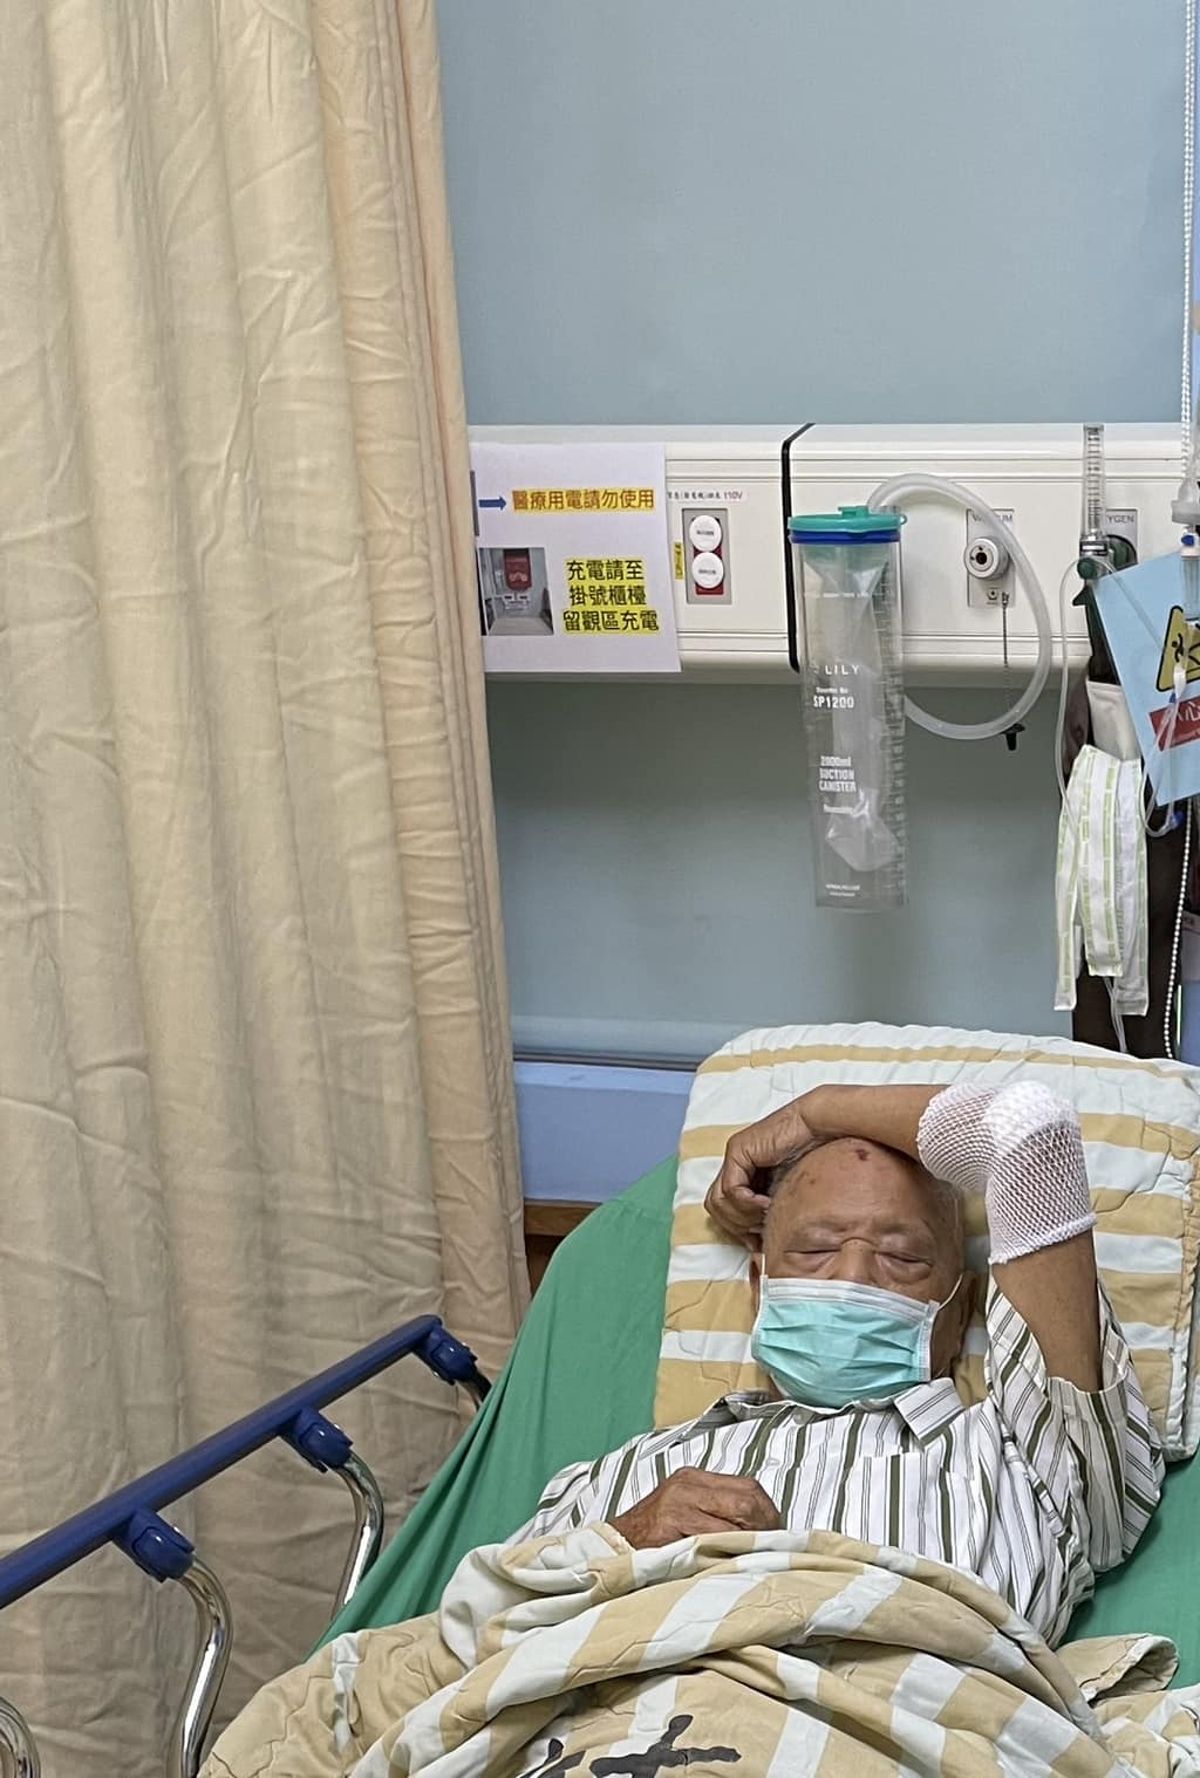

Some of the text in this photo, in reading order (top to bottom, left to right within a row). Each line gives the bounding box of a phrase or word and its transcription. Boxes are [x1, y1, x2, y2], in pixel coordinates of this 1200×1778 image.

[511, 488, 655, 511] 醫療用電請勿使用
[1106, 513, 1135, 524] YGEN
[566, 559, 645, 581] 充電請至
[562, 609, 660, 632] 留觀區充電
[824, 664, 860, 676] LILY
[812, 694, 855, 709] SP1200
